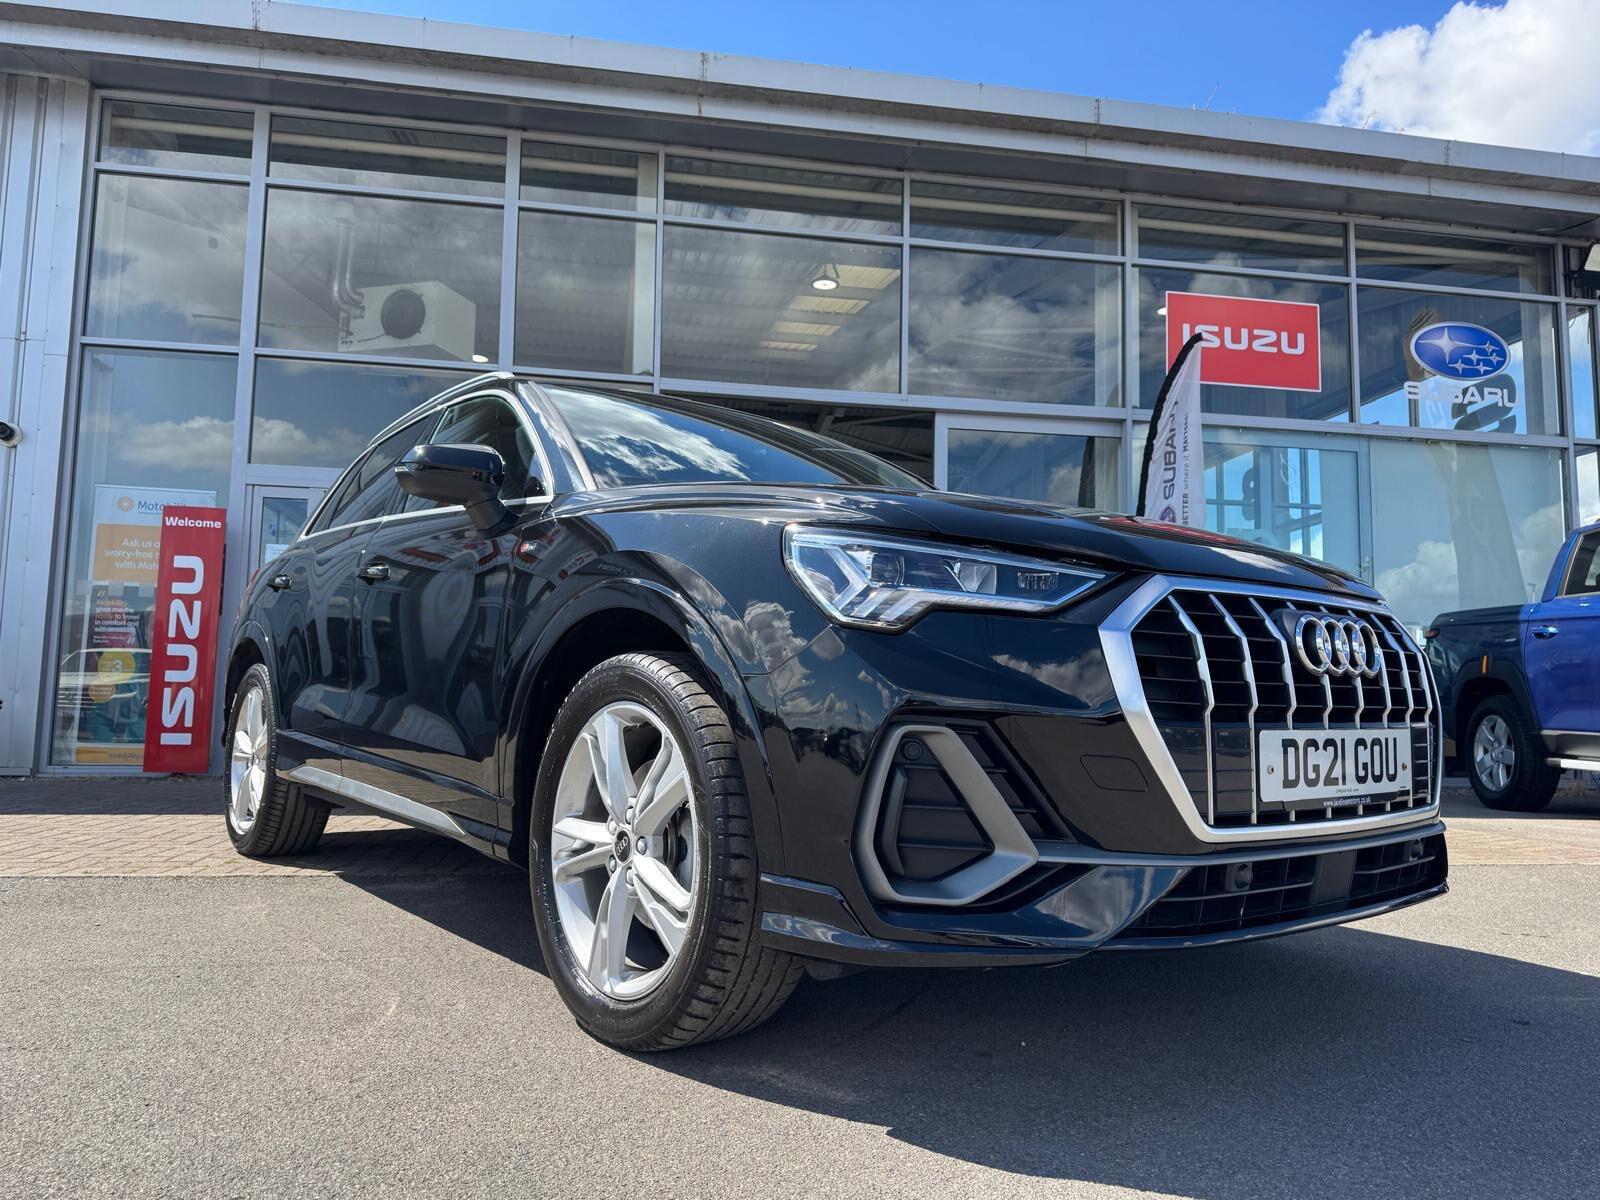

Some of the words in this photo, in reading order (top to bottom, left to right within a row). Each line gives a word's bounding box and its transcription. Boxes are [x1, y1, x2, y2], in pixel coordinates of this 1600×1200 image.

[1182, 322, 1305, 355] ISUZU
[164, 516, 222, 529] Welcome
[121, 538, 141, 547] Ask
[160, 555, 205, 746] ISUZU
[1281, 738, 1347, 789] DG21
[1354, 737, 1398, 785] GOU
